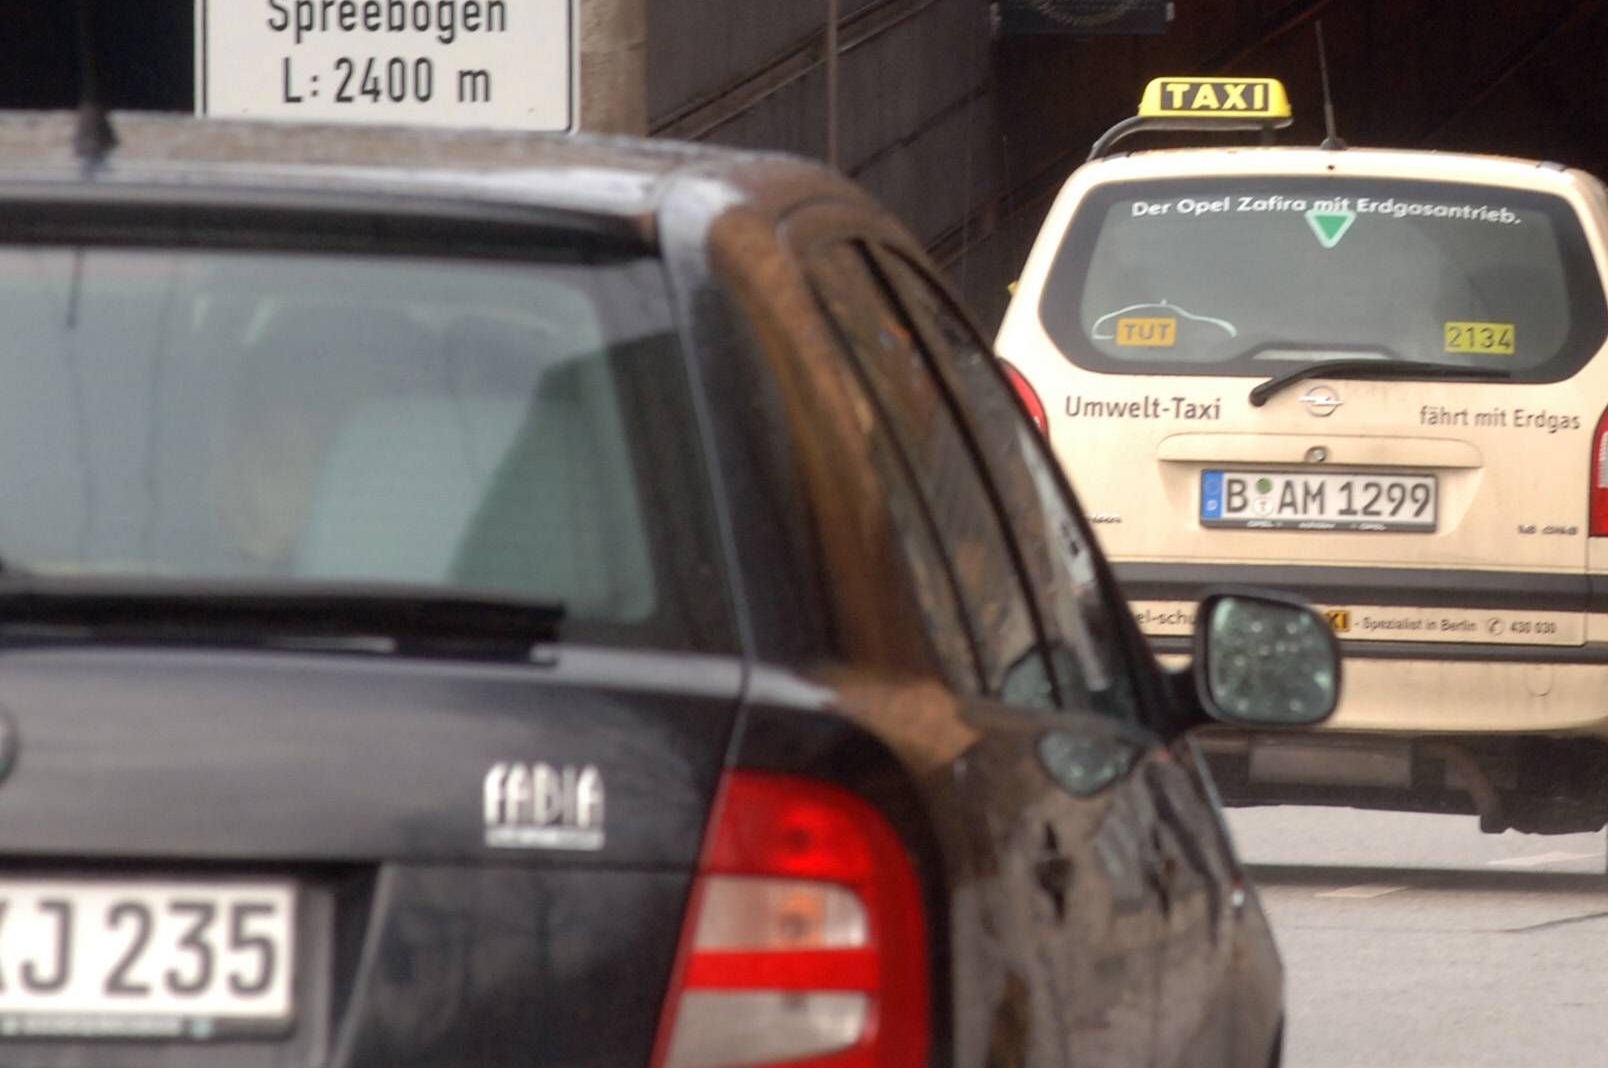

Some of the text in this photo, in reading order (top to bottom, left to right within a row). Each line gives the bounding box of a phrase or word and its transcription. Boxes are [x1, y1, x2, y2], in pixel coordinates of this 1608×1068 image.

[281, 57, 492, 103] L: 2400 m
[1165, 83, 1265, 110] TAXI
[1131, 201, 1172, 216] Der
[1176, 196, 1231, 216] Opel
[1237, 195, 1307, 212] Zafira
[1313, 196, 1351, 213] mit
[1124, 323, 1171, 341] TUT
[1447, 326, 1512, 350] 2134
[1065, 395, 1222, 420] Umwelt-Taxi
[1420, 405, 1582, 434] fährt mit Erdgas
[1226, 478, 1431, 518] B AM 1299
[1441, 618, 1478, 631] Berlin
[0, 899, 278, 999] J 235
